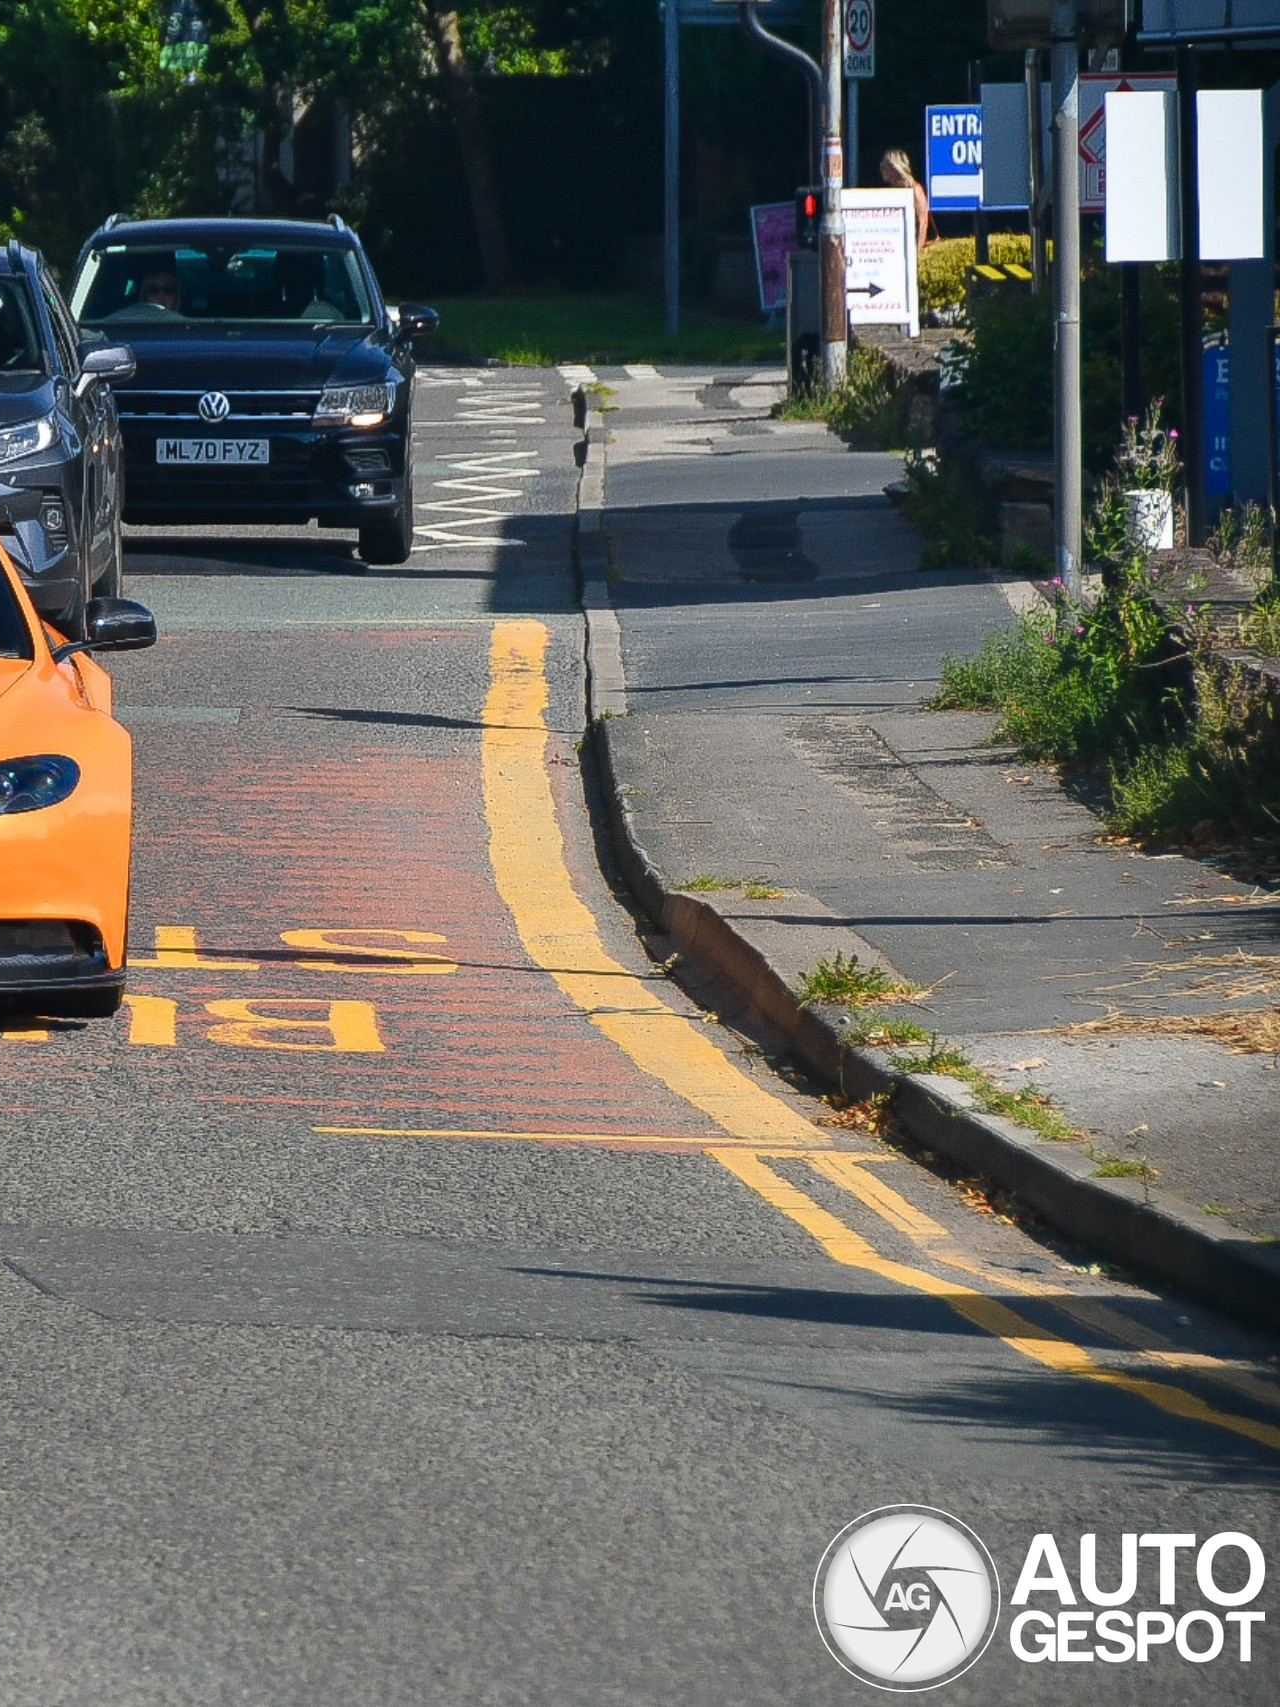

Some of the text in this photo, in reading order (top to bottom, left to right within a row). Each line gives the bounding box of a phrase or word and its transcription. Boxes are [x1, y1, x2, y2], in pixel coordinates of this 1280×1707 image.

[849, 9, 869, 34] 20
[846, 54, 873, 72] ZONE
[165, 441, 260, 460] ML70 FYZ
